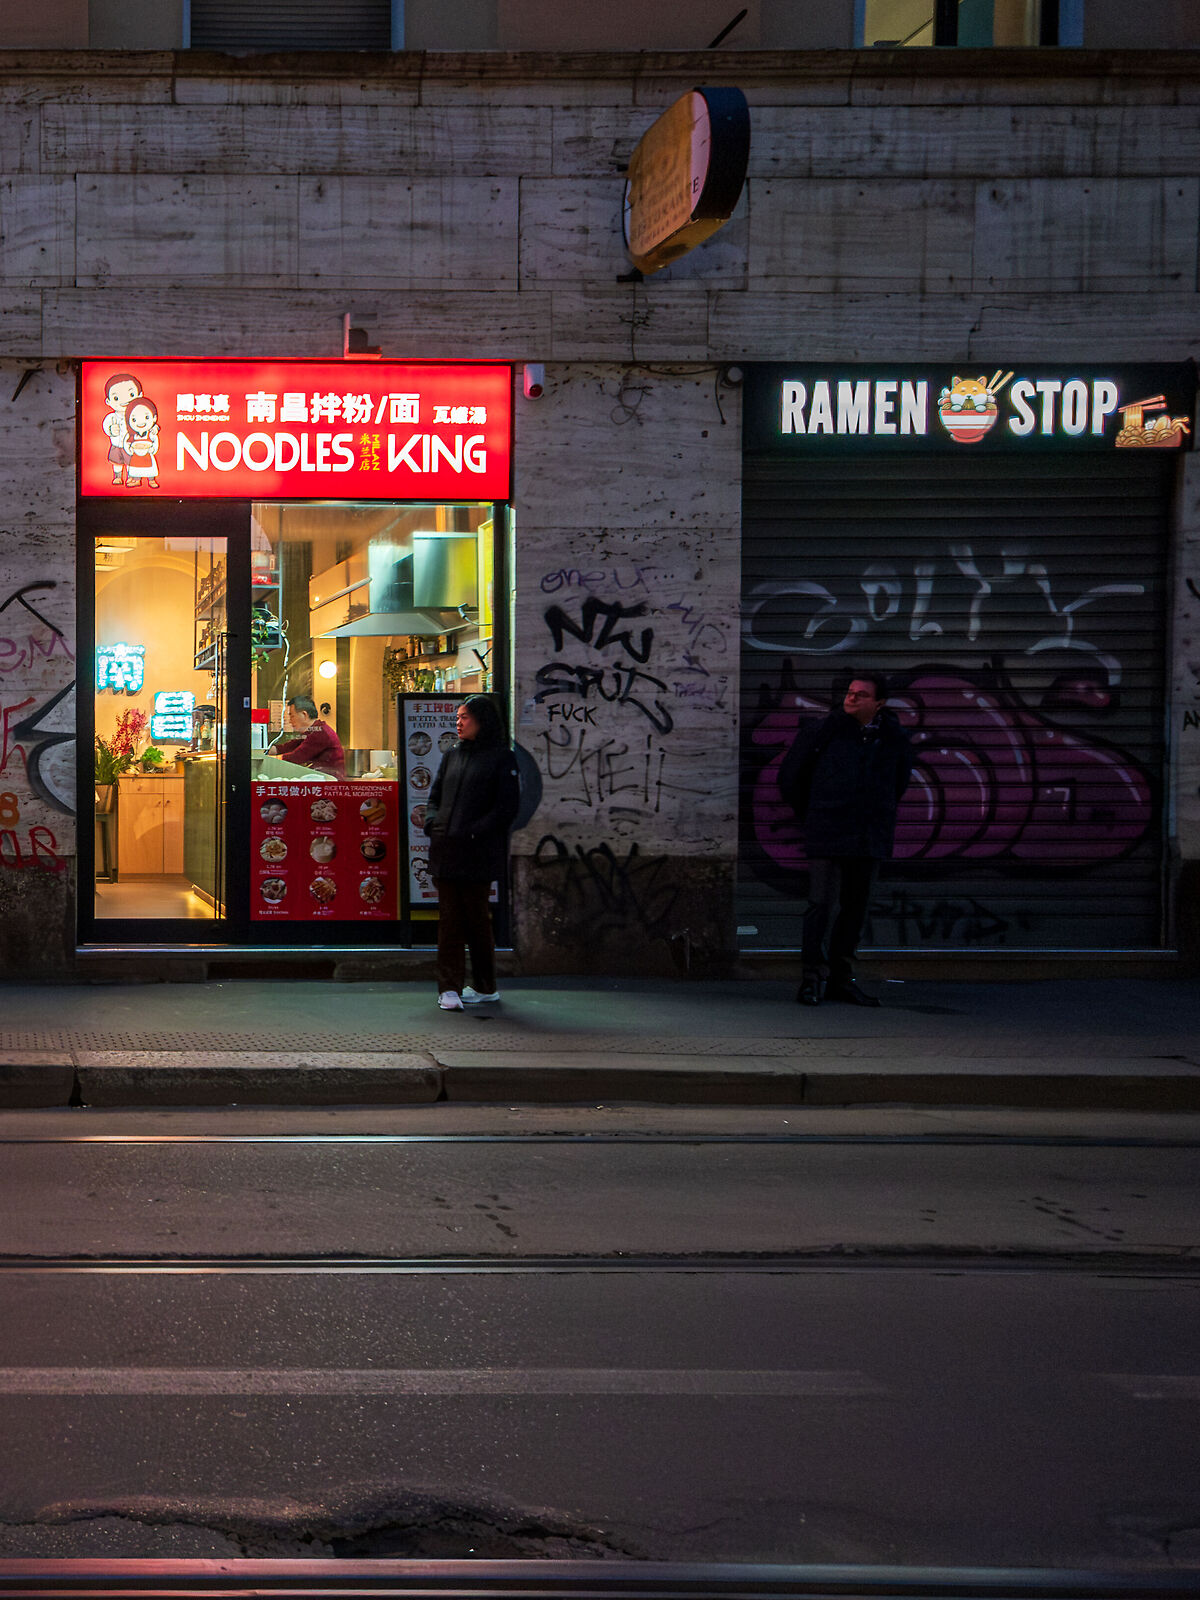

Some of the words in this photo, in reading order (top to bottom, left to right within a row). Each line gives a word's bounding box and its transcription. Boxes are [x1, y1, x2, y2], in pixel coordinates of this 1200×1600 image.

[245, 391, 420, 424] 南昌拌粉/面
[780, 380, 928, 435] RAMEN
[1009, 379, 1118, 436] STOP
[176, 431, 355, 473] NOODLES
[388, 433, 487, 473] KING
[359, 433, 371, 471] 米兰店
[371, 434, 380, 471] MILAN
[548, 704, 597, 726] FUCK
[256, 785, 322, 798] 手工现做小吃
